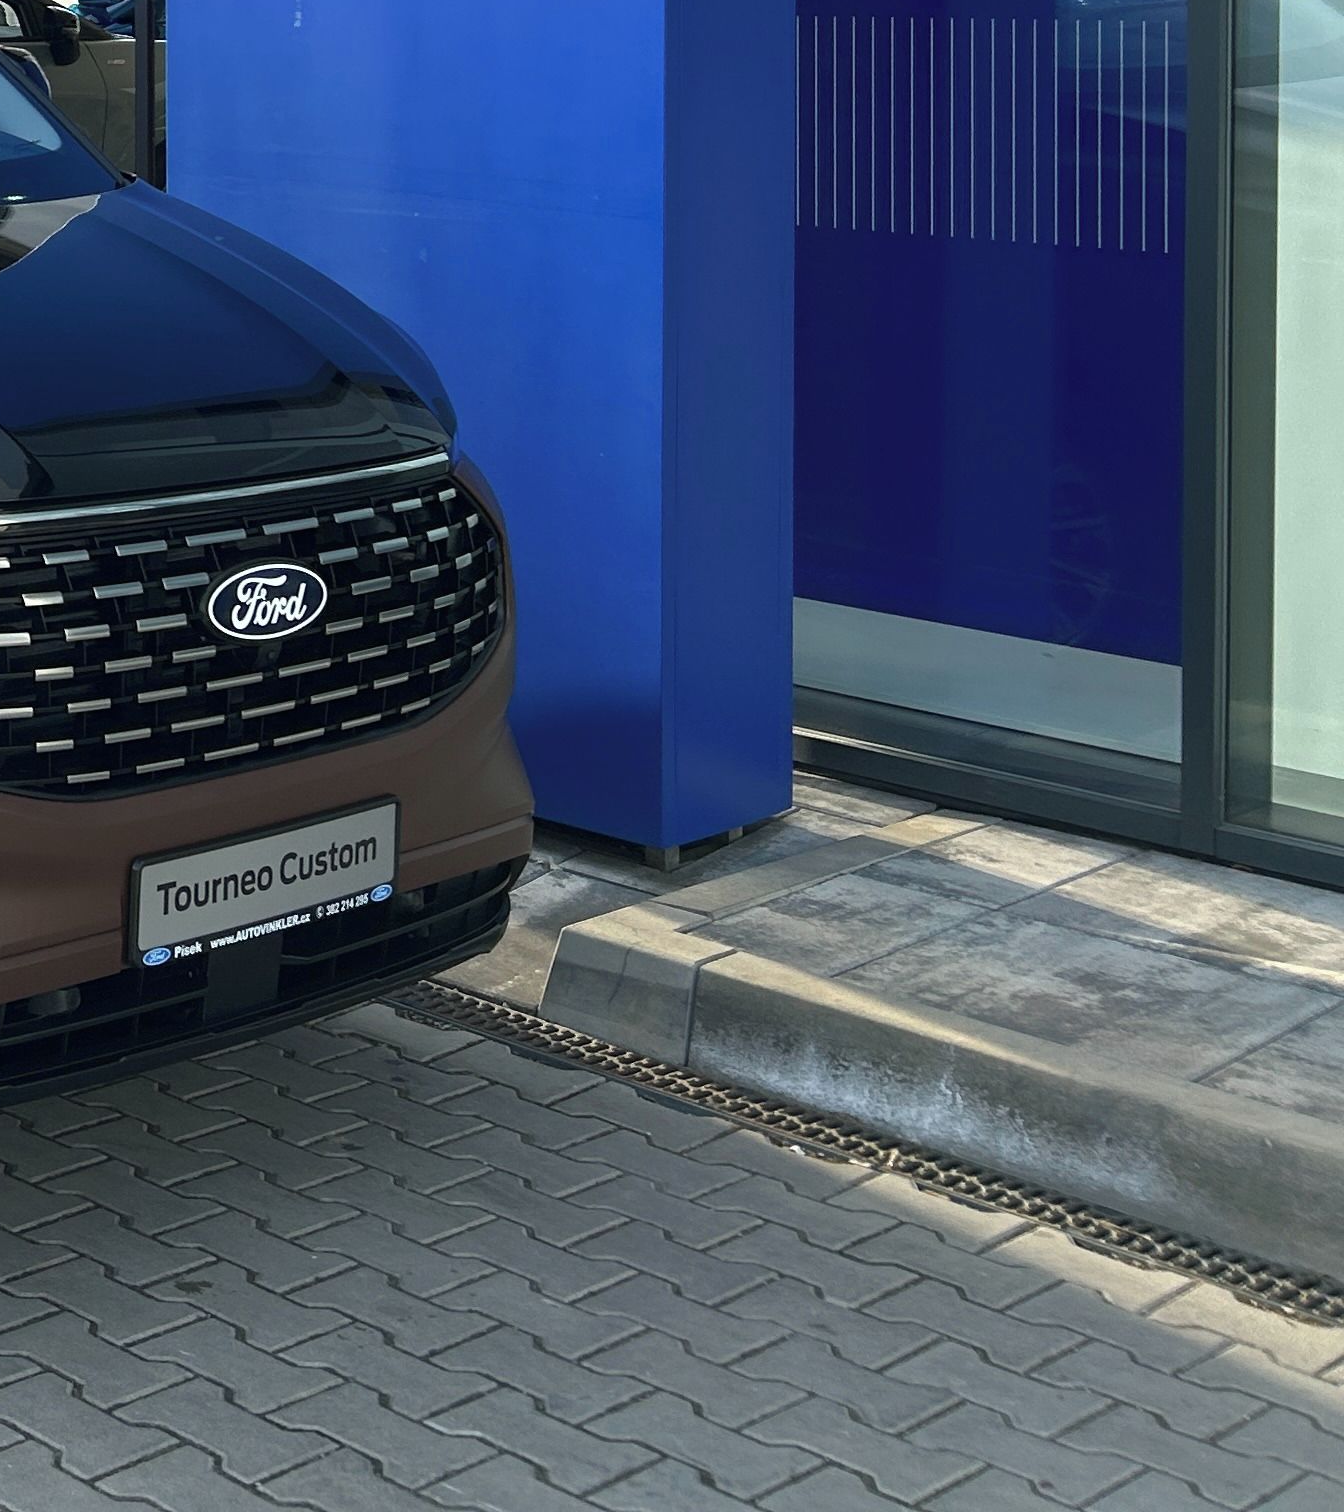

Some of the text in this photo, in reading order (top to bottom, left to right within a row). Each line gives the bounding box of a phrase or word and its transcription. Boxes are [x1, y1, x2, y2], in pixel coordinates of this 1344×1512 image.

[231, 574, 308, 630] Ford
[156, 836, 378, 916] Tourneo Custom
